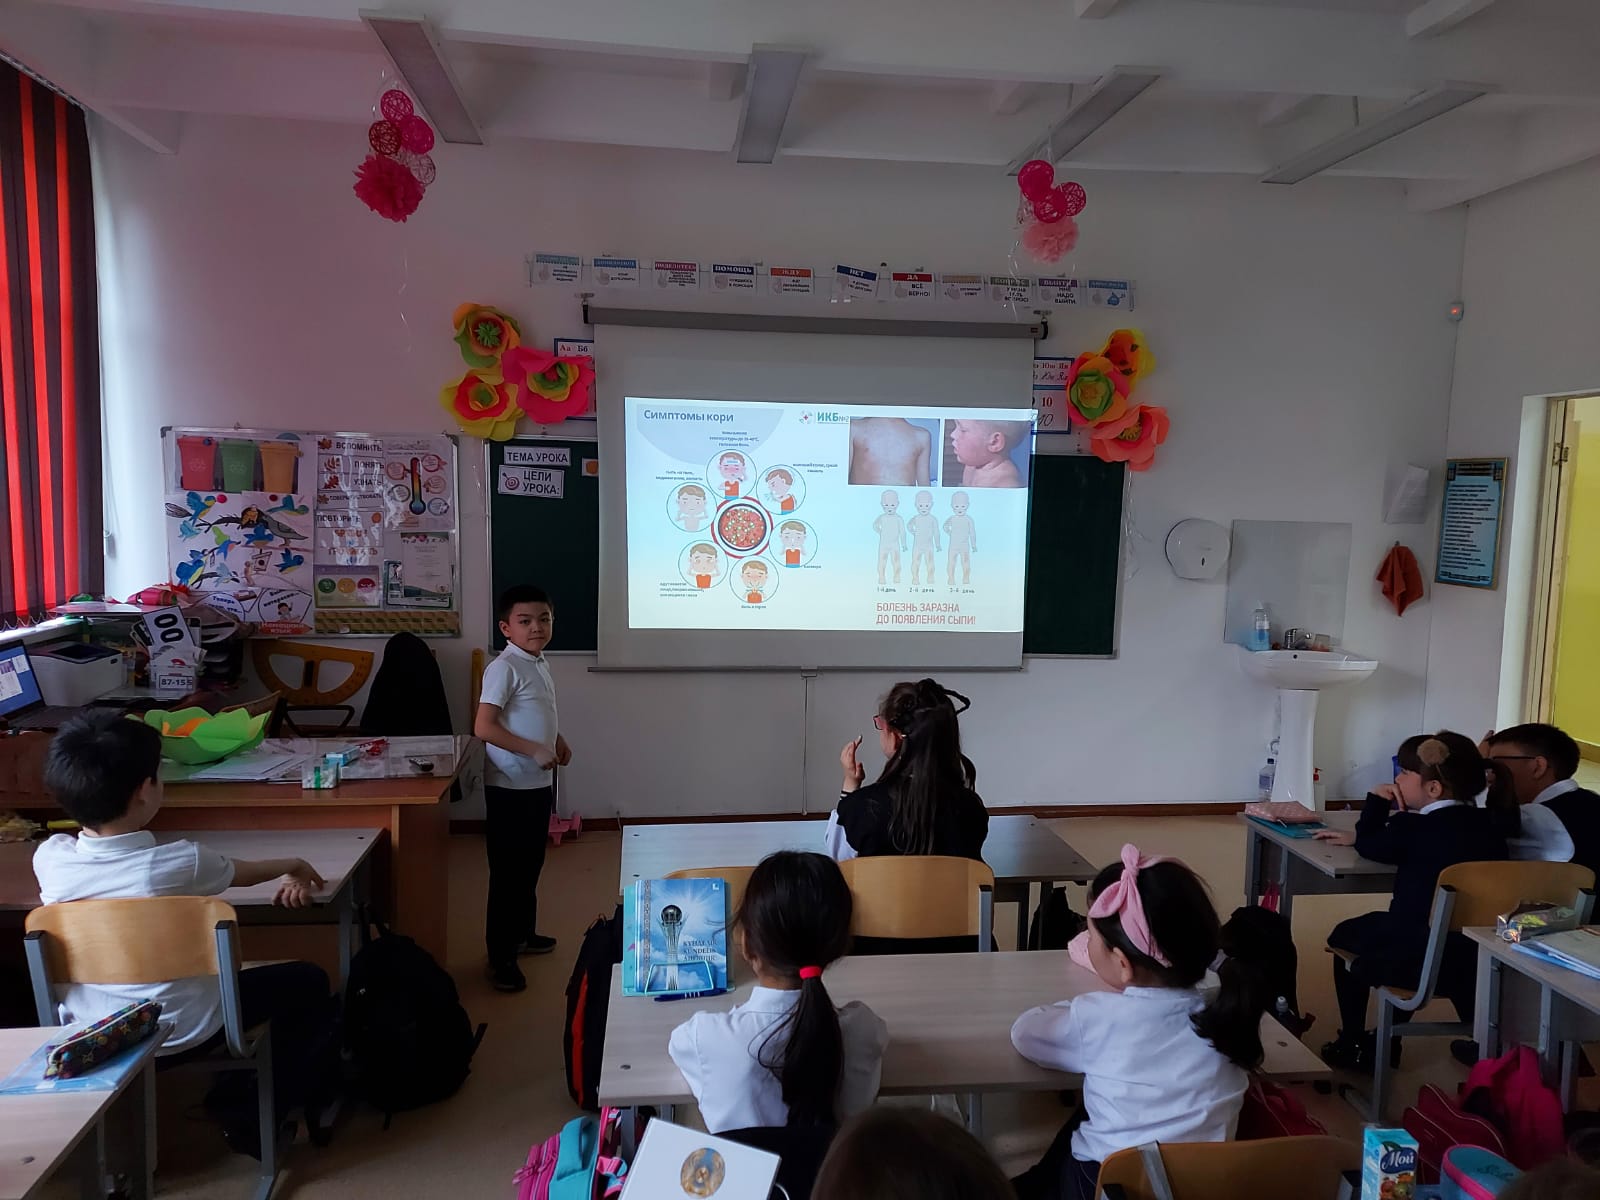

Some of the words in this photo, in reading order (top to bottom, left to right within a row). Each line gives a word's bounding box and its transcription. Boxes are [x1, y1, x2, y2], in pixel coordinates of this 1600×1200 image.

[1042, 397, 1053, 407] 10
[644, 409, 704, 420] Симптомы
[707, 413, 734, 424] кори
[507, 452, 534, 462] ТЕМА
[536, 452, 568, 463] УРОКА
[523, 470, 552, 481] ЦЕЛИ
[522, 482, 560, 494] УРОКА:
[876, 603, 917, 612] БОЛЕЗНЬ
[920, 603, 960, 612] ЗАРАЗНА
[876, 615, 889, 625] ДО
[892, 615, 945, 624] ПОЯВЛЕНИЯ
[948, 616, 976, 625] СЫПИ!
[1381, 1152, 1414, 1170] Мой
